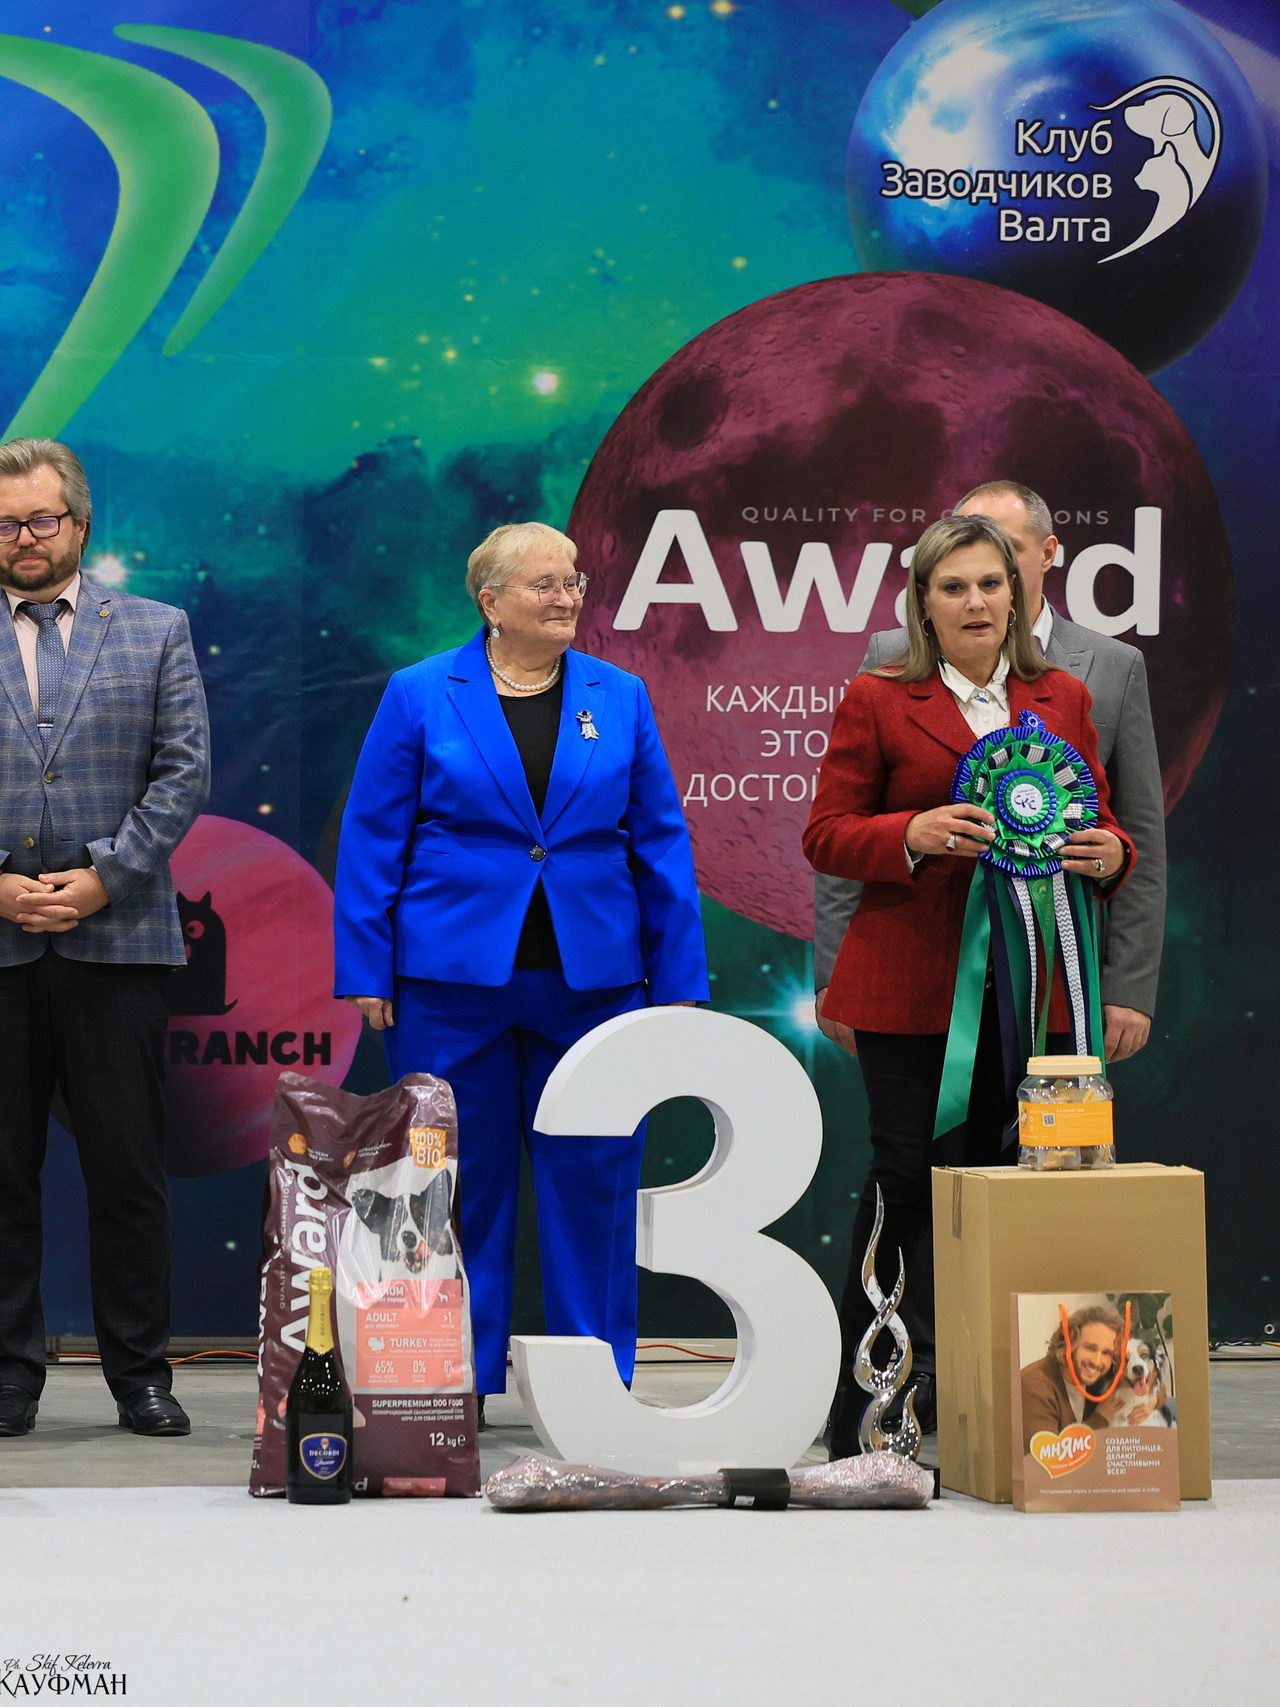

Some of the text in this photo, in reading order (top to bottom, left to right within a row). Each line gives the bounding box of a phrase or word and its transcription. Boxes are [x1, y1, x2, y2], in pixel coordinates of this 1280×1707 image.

[1018, 119, 1113, 161] Клуб
[881, 162, 1113, 203] Заводчиков
[999, 210, 1111, 242] Валта
[741, 506, 856, 524] QUALITY
[873, 508, 926, 524] FOR
[613, 506, 1163, 637] Awd
[760, 729, 829, 758] ЭТО
[170, 1030, 331, 1066] RANCH
[414, 1130, 442, 1147] 100%
[416, 1146, 442, 1166] BIO
[510, 1006, 842, 1475] 3
[280, 1159, 328, 1354] Award
[365, 1312, 398, 1323] ADULT
[389, 1337, 428, 1348] TURKEY
[374, 1360, 395, 1374] 65%
[412, 1360, 427, 1374] 0%
[444, 1359, 455, 1374] 0%
[372, 1398, 464, 1408] SUPERPREMIUM DOG FOOD
[429, 1431, 445, 1447] 12
[1105, 1437, 1141, 1445] СОЗДАНЫ
[1106, 1444, 1163, 1453] ДЛЯ ПИТОМЦЕВ,
[1106, 1453, 1136, 1461] ДЕЛАЮТ
[1107, 1467, 1127, 1475] ВСЕХ!
